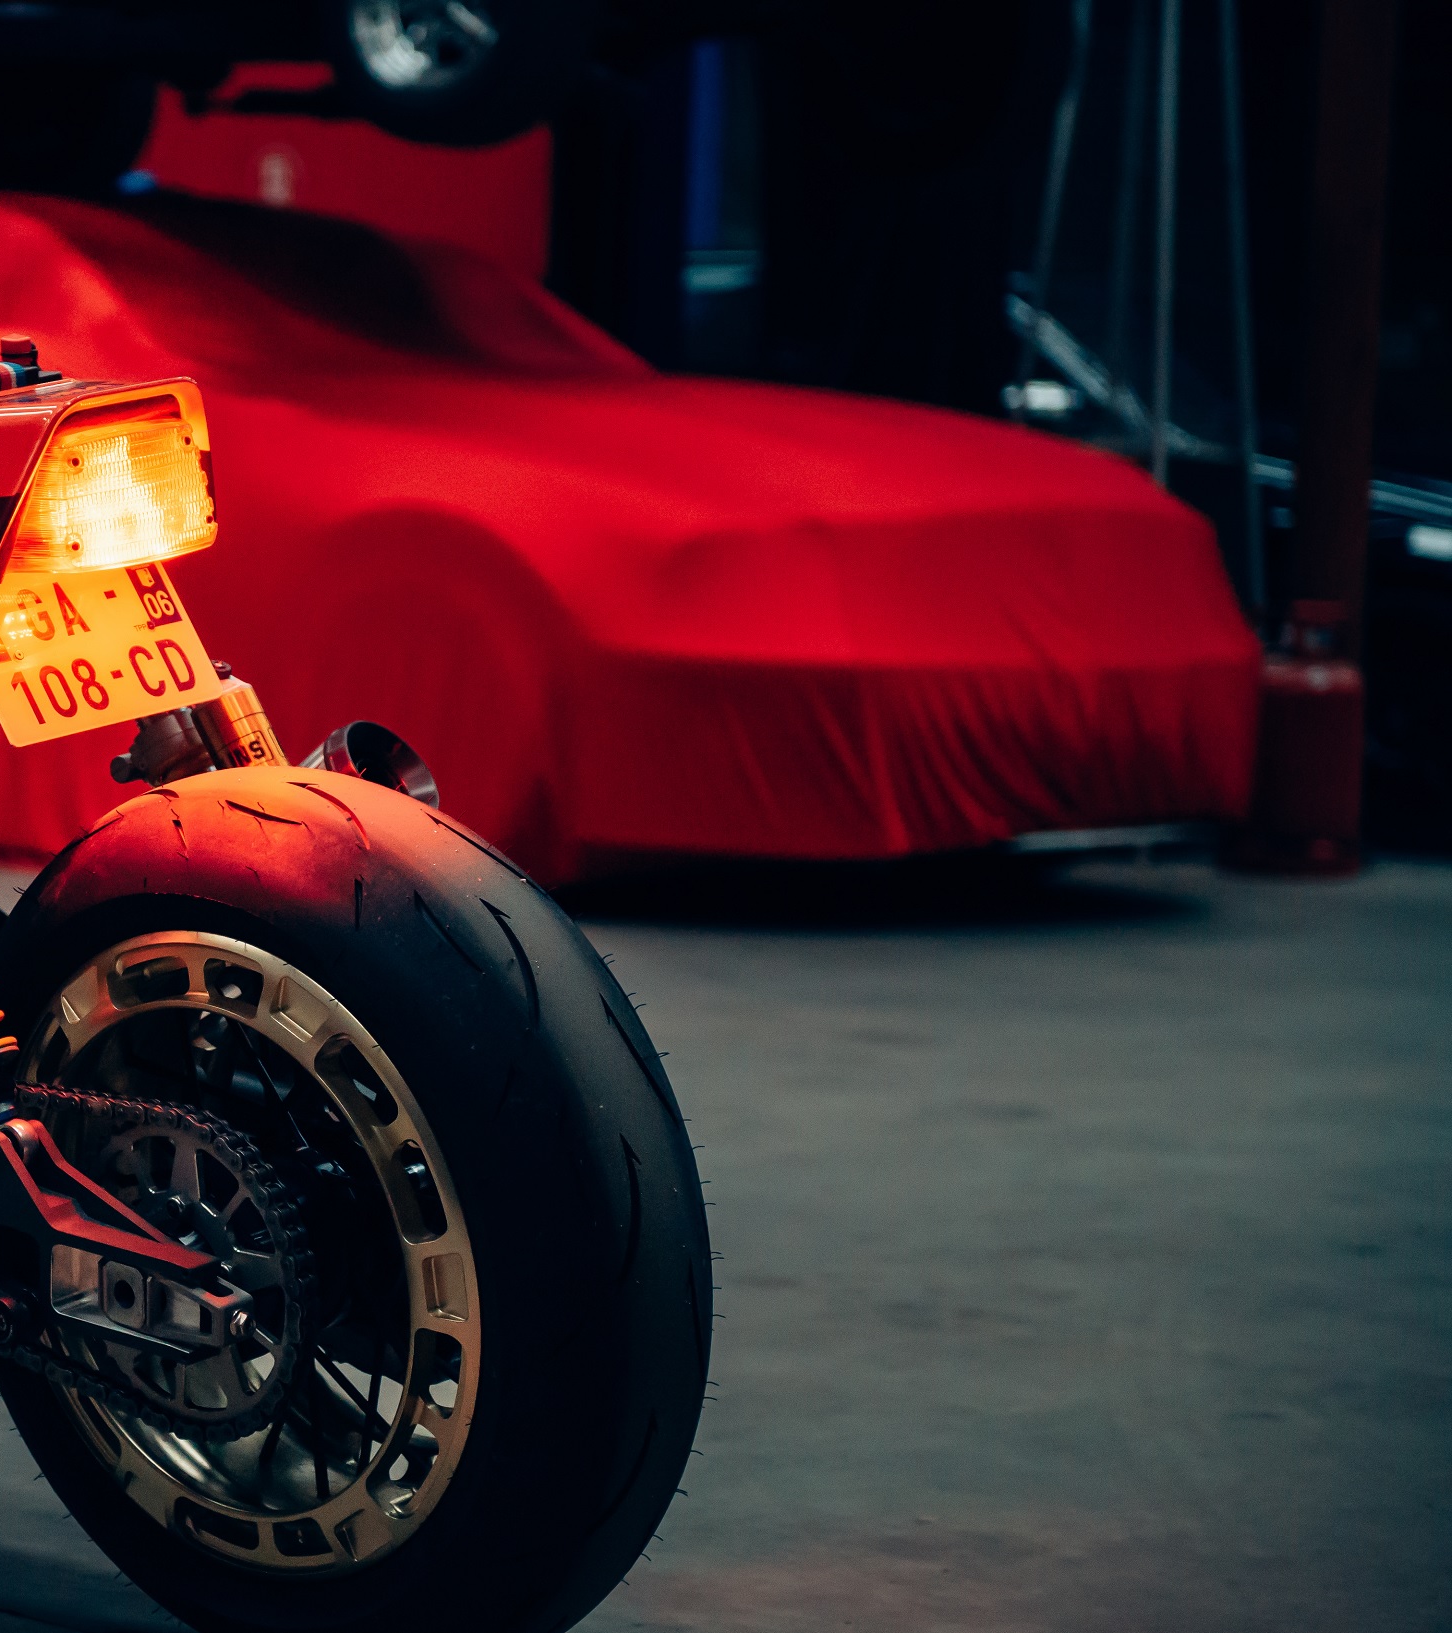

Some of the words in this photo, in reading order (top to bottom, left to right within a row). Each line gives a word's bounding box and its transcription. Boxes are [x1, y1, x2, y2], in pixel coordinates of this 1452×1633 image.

[16, 582, 91, 641] GA
[143, 590, 175, 619] 06
[11, 638, 196, 725] 108-CD
